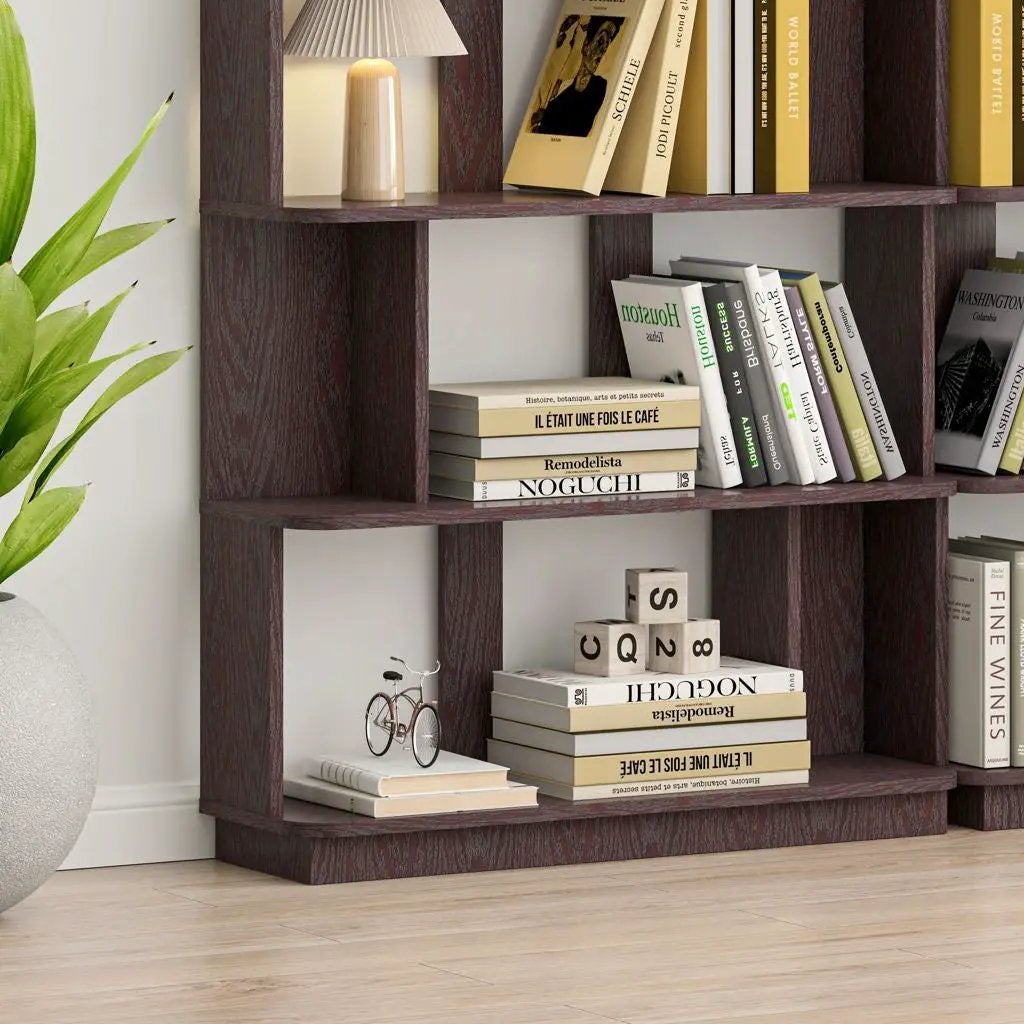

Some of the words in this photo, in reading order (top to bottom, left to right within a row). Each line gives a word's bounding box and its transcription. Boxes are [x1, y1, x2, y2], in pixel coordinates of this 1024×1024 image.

[675, 13, 685, 47] second
[788, 16, 799, 66] WORLD
[611, 59, 641, 122] SCHIELE
[661, 71, 679, 126] PICOULT
[788, 71, 799, 120] BALLET
[656, 125, 669, 158] JODI
[535, 415, 544, 429] IL
[546, 412, 572, 428] ÉTAIT
[575, 413, 595, 426] UNE
[598, 412, 618, 426] FOIS
[621, 411, 633, 424] LE
[635, 407, 659, 424] CAFÉ
[992, 365, 1024, 449] WASHINGTON
[544, 455, 622, 471] Remodelista
[518, 475, 640, 497] NOGUCHI
[650, 587, 678, 610] S
[990, 591, 1006, 646] FINE
[580, 634, 600, 661] C
[616, 632, 638, 664] Q
[656, 637, 676, 658] 2
[692, 637, 713, 658] 8
[626, 676, 757, 703] NOGUCHI
[990, 656, 1006, 740] WINES
[652, 706, 735, 722] Remodelista
